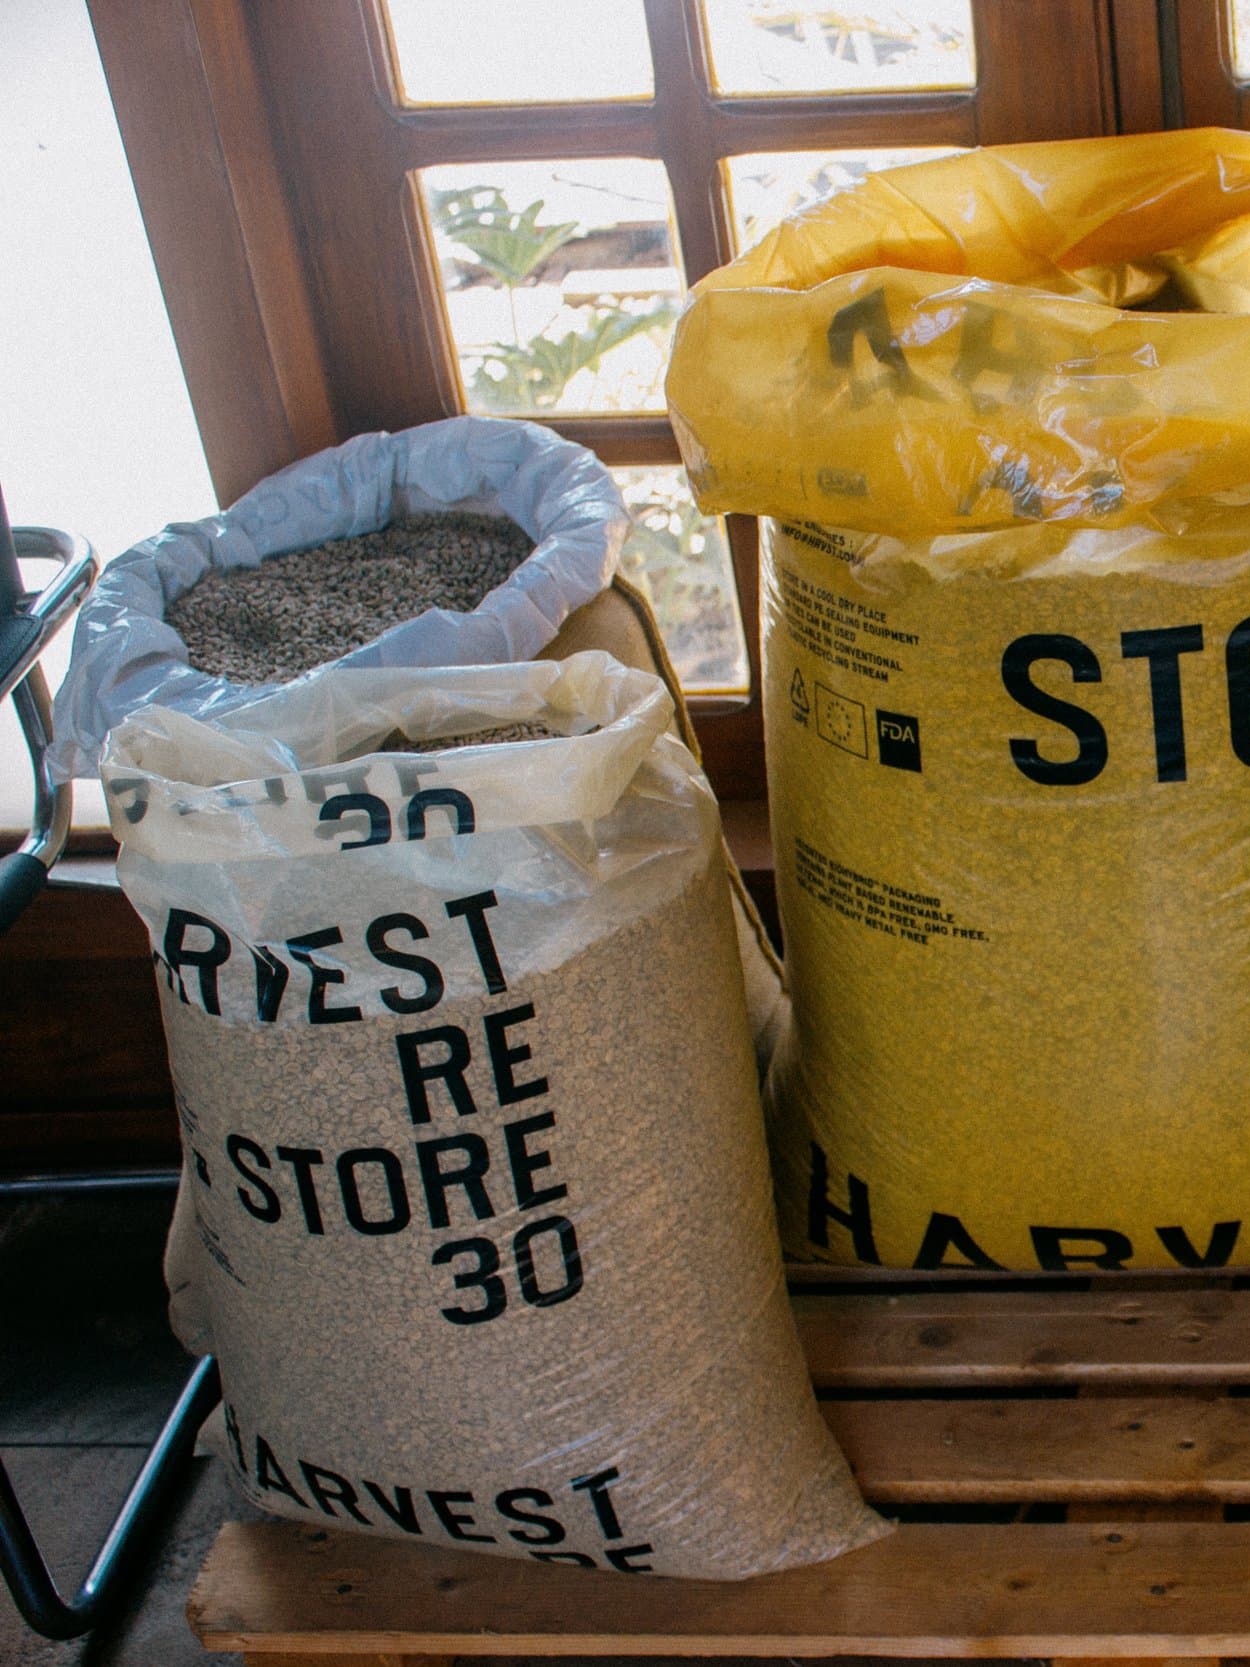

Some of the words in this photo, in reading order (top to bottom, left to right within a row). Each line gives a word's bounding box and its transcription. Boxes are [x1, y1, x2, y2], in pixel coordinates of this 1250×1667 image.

[857, 604, 887, 624] PLACE
[863, 622, 920, 646] EQUIPMENT
[834, 640, 903, 673] CONVENTIONAL
[852, 661, 889, 683] STREAM
[880, 720, 915, 744] FDA
[882, 883, 941, 908] PACKAGING
[889, 898, 955, 924] RENEWABLE
[395, 1004, 549, 1125] RE
[226, 1113, 568, 1236] STORE
[431, 1215, 584, 1325] 30
